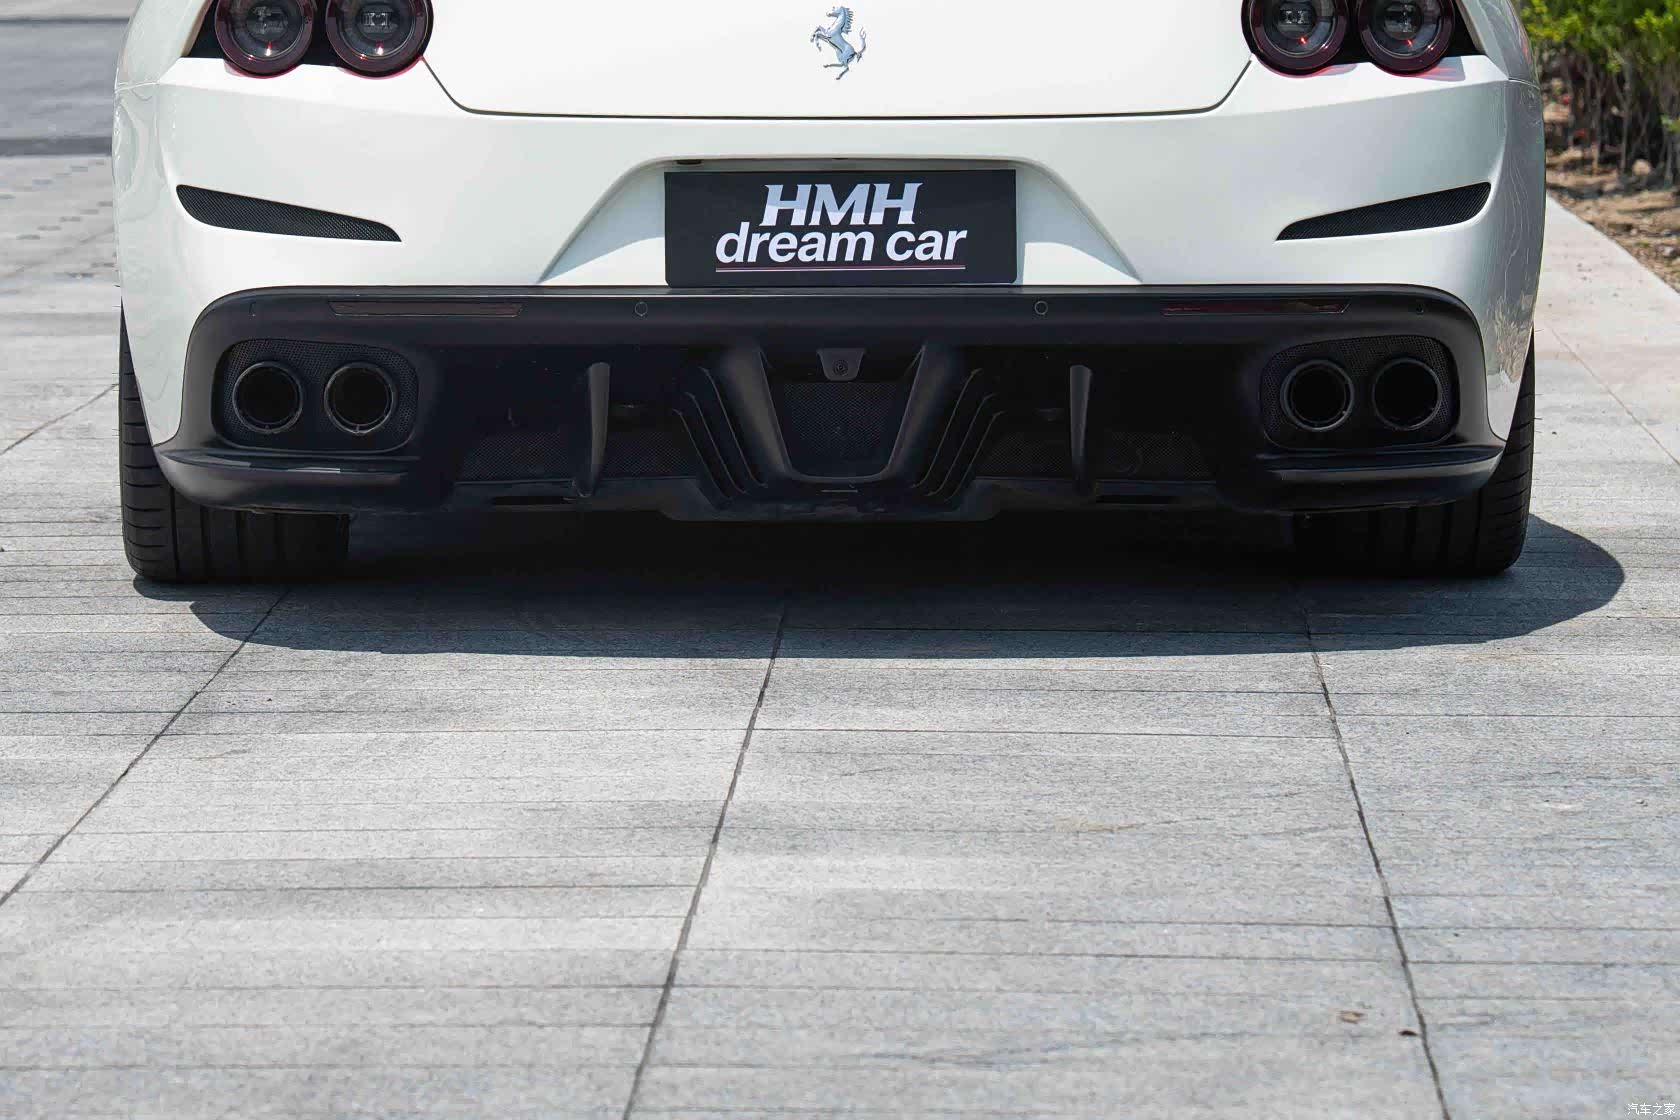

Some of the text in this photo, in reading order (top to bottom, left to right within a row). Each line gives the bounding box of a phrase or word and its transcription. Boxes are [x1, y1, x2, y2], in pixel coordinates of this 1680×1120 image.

[759, 182, 924, 227] HMH
[715, 221, 968, 263] dream car
